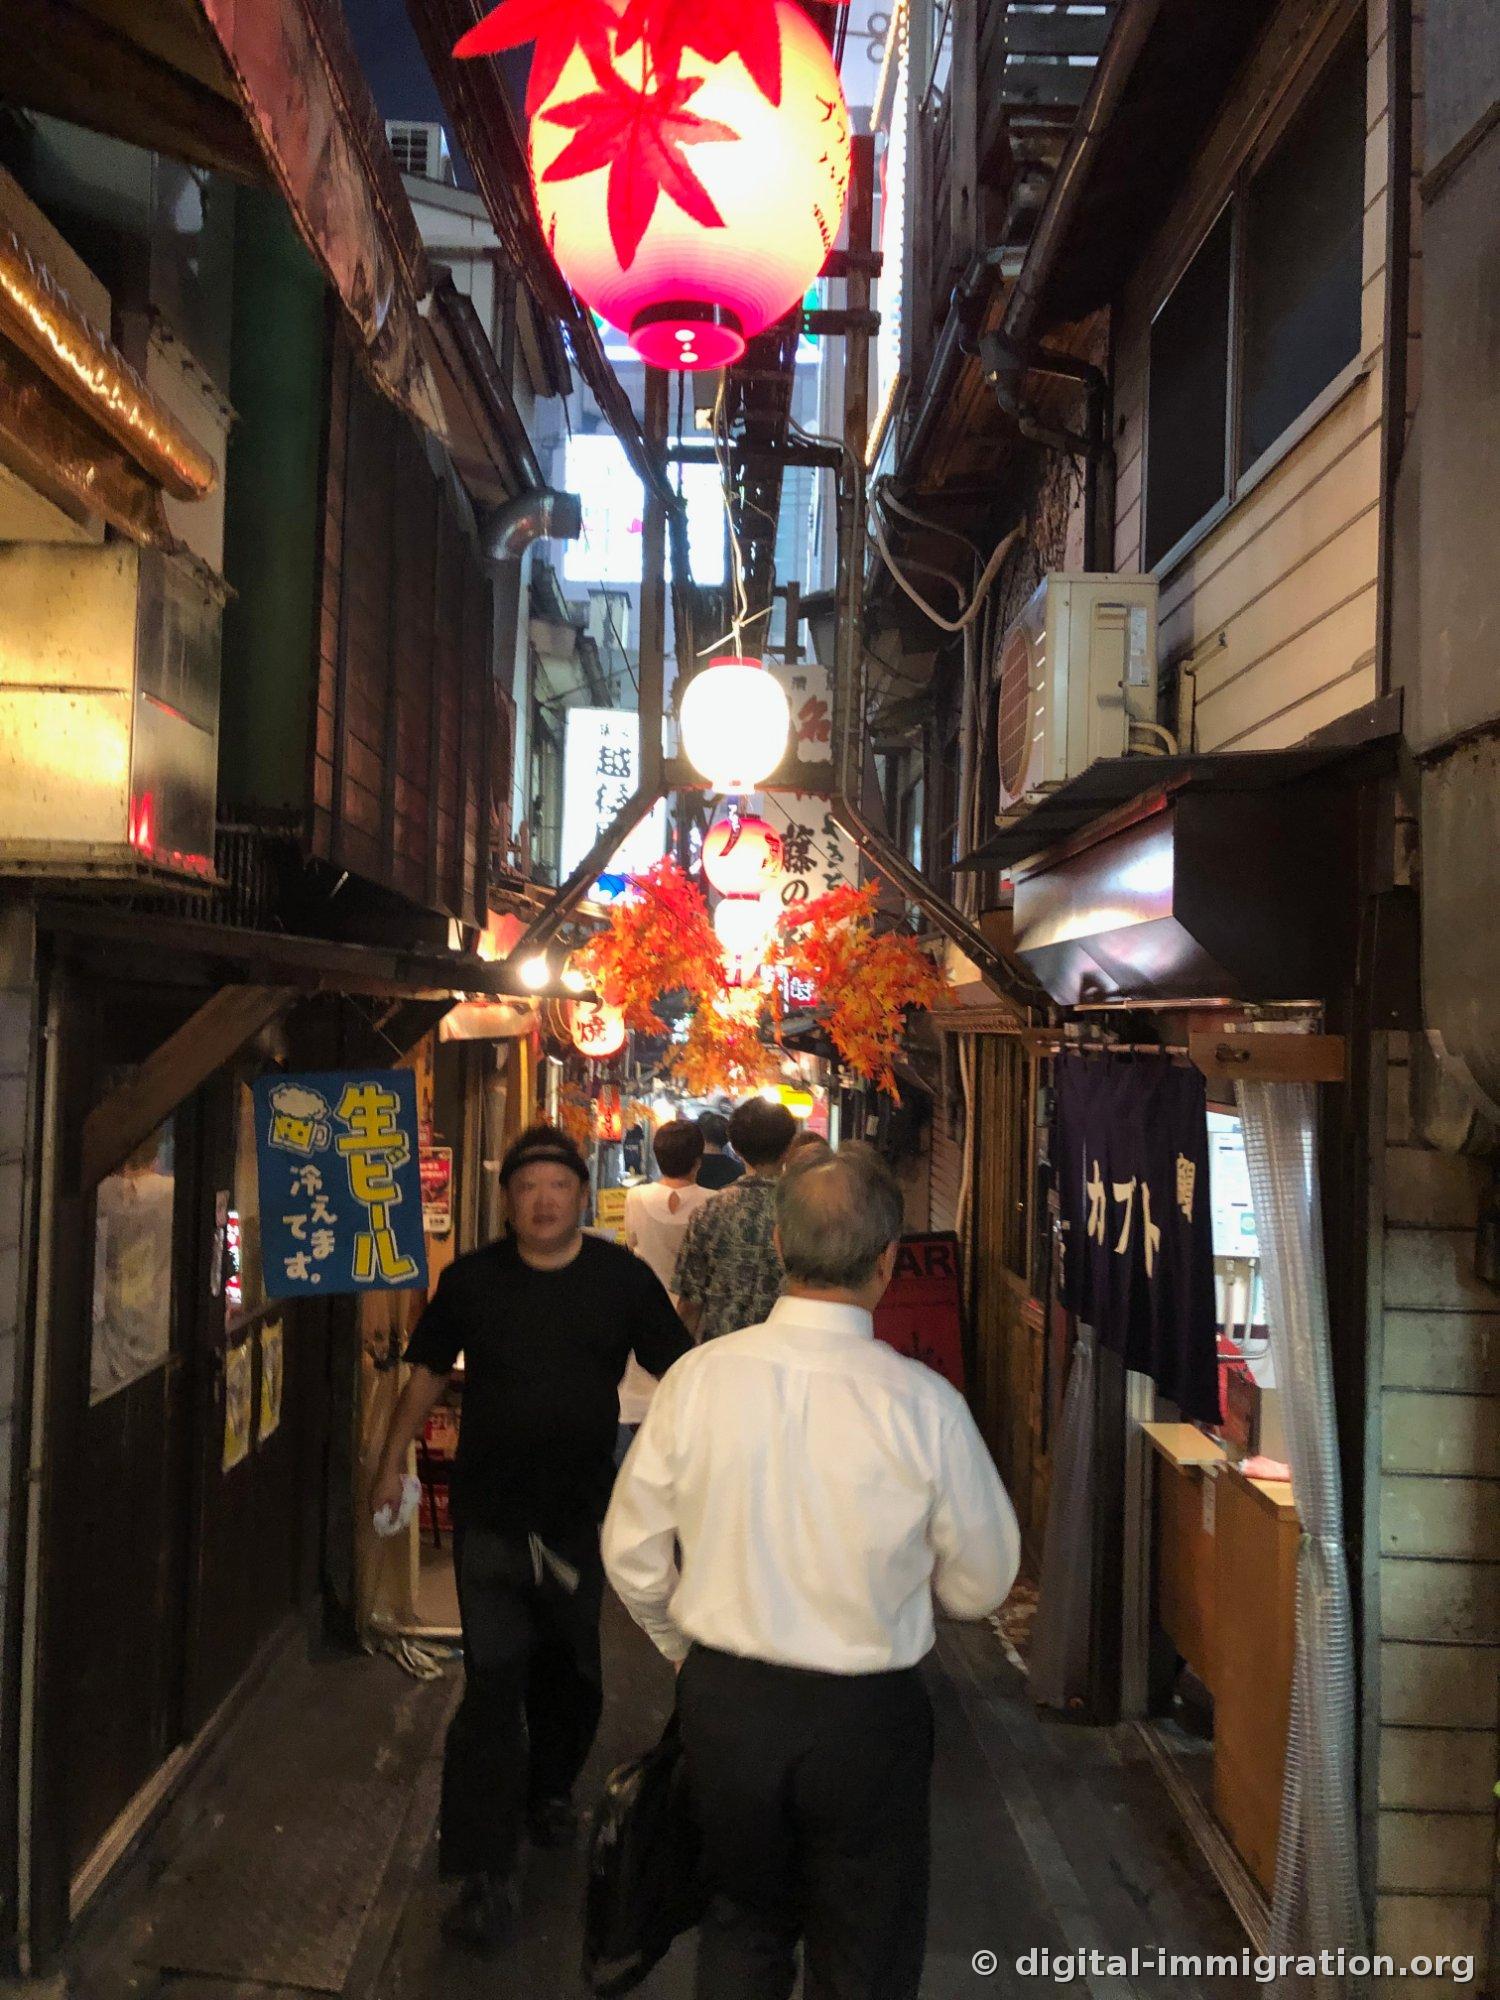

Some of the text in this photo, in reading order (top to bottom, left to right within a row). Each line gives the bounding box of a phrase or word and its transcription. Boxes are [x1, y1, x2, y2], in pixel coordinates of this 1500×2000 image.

[282, 1163, 337, 1284] 冷えてます。
[334, 1082, 419, 1284] 生ビール
